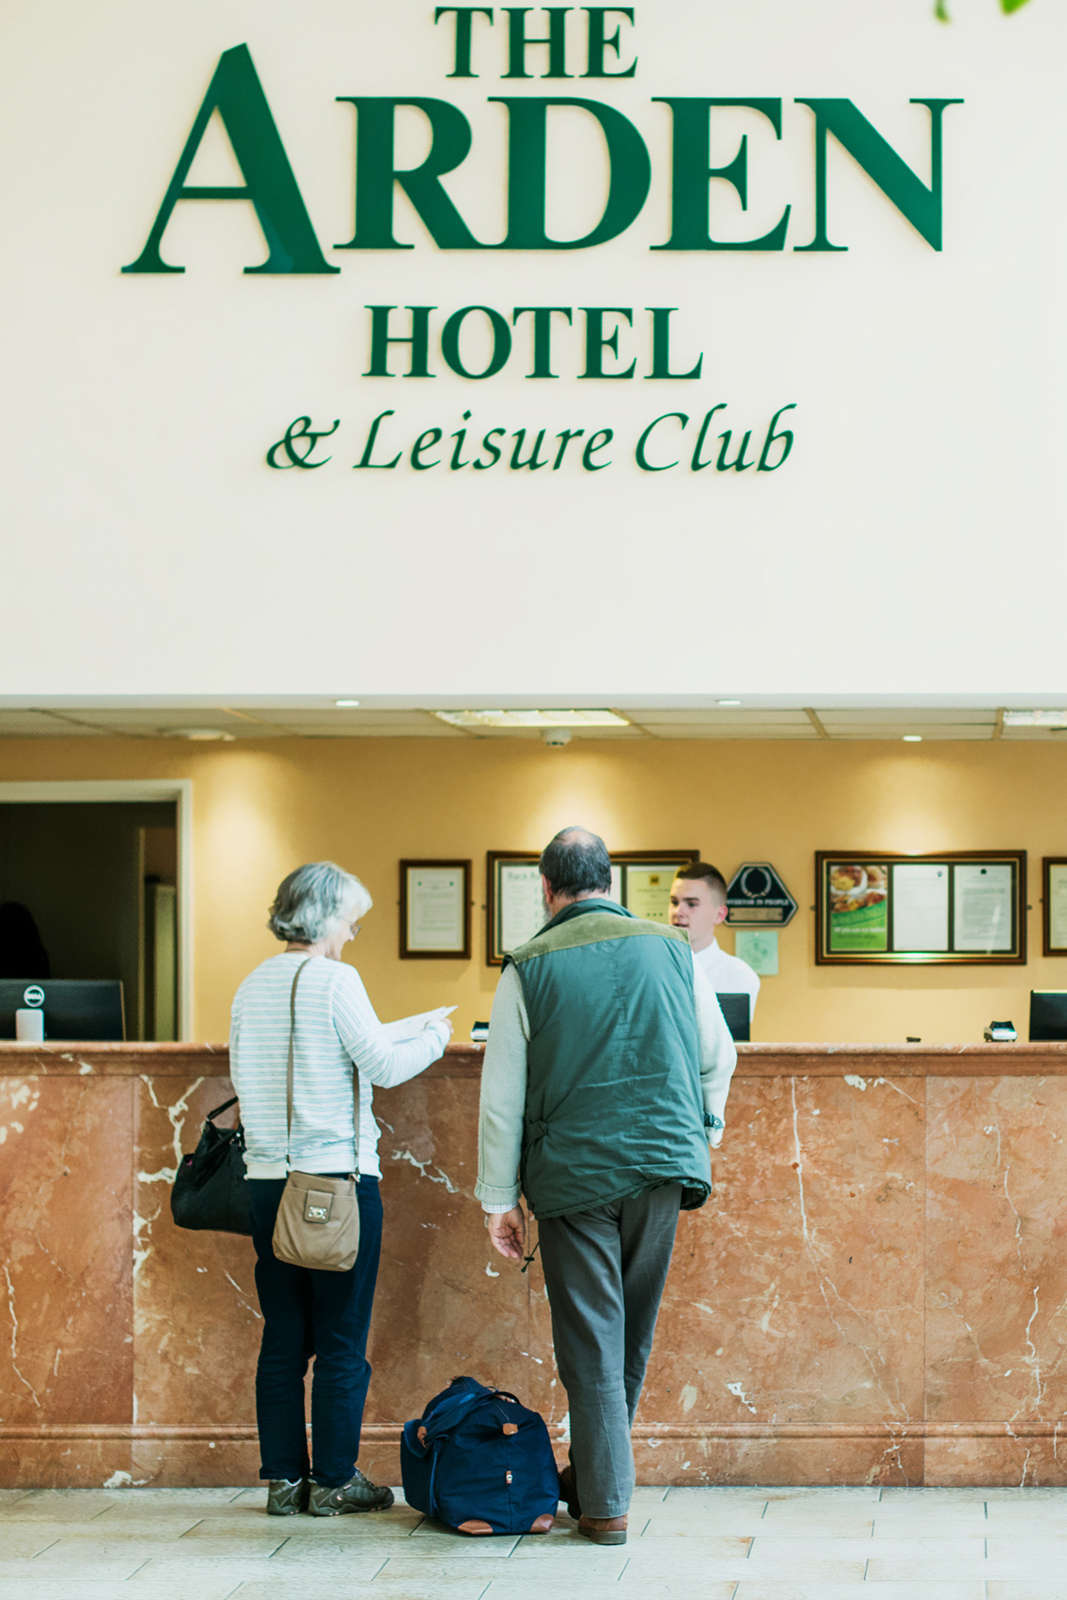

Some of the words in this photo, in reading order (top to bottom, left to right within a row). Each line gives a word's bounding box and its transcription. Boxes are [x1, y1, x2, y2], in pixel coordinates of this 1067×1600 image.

[435, 6, 638, 78] THE
[121, 42, 964, 274] ARDEN
[362, 305, 704, 379] HOTEL
[266, 416, 341, 470] &
[352, 410, 613, 471] Leisure
[635, 403, 797, 472] Club
